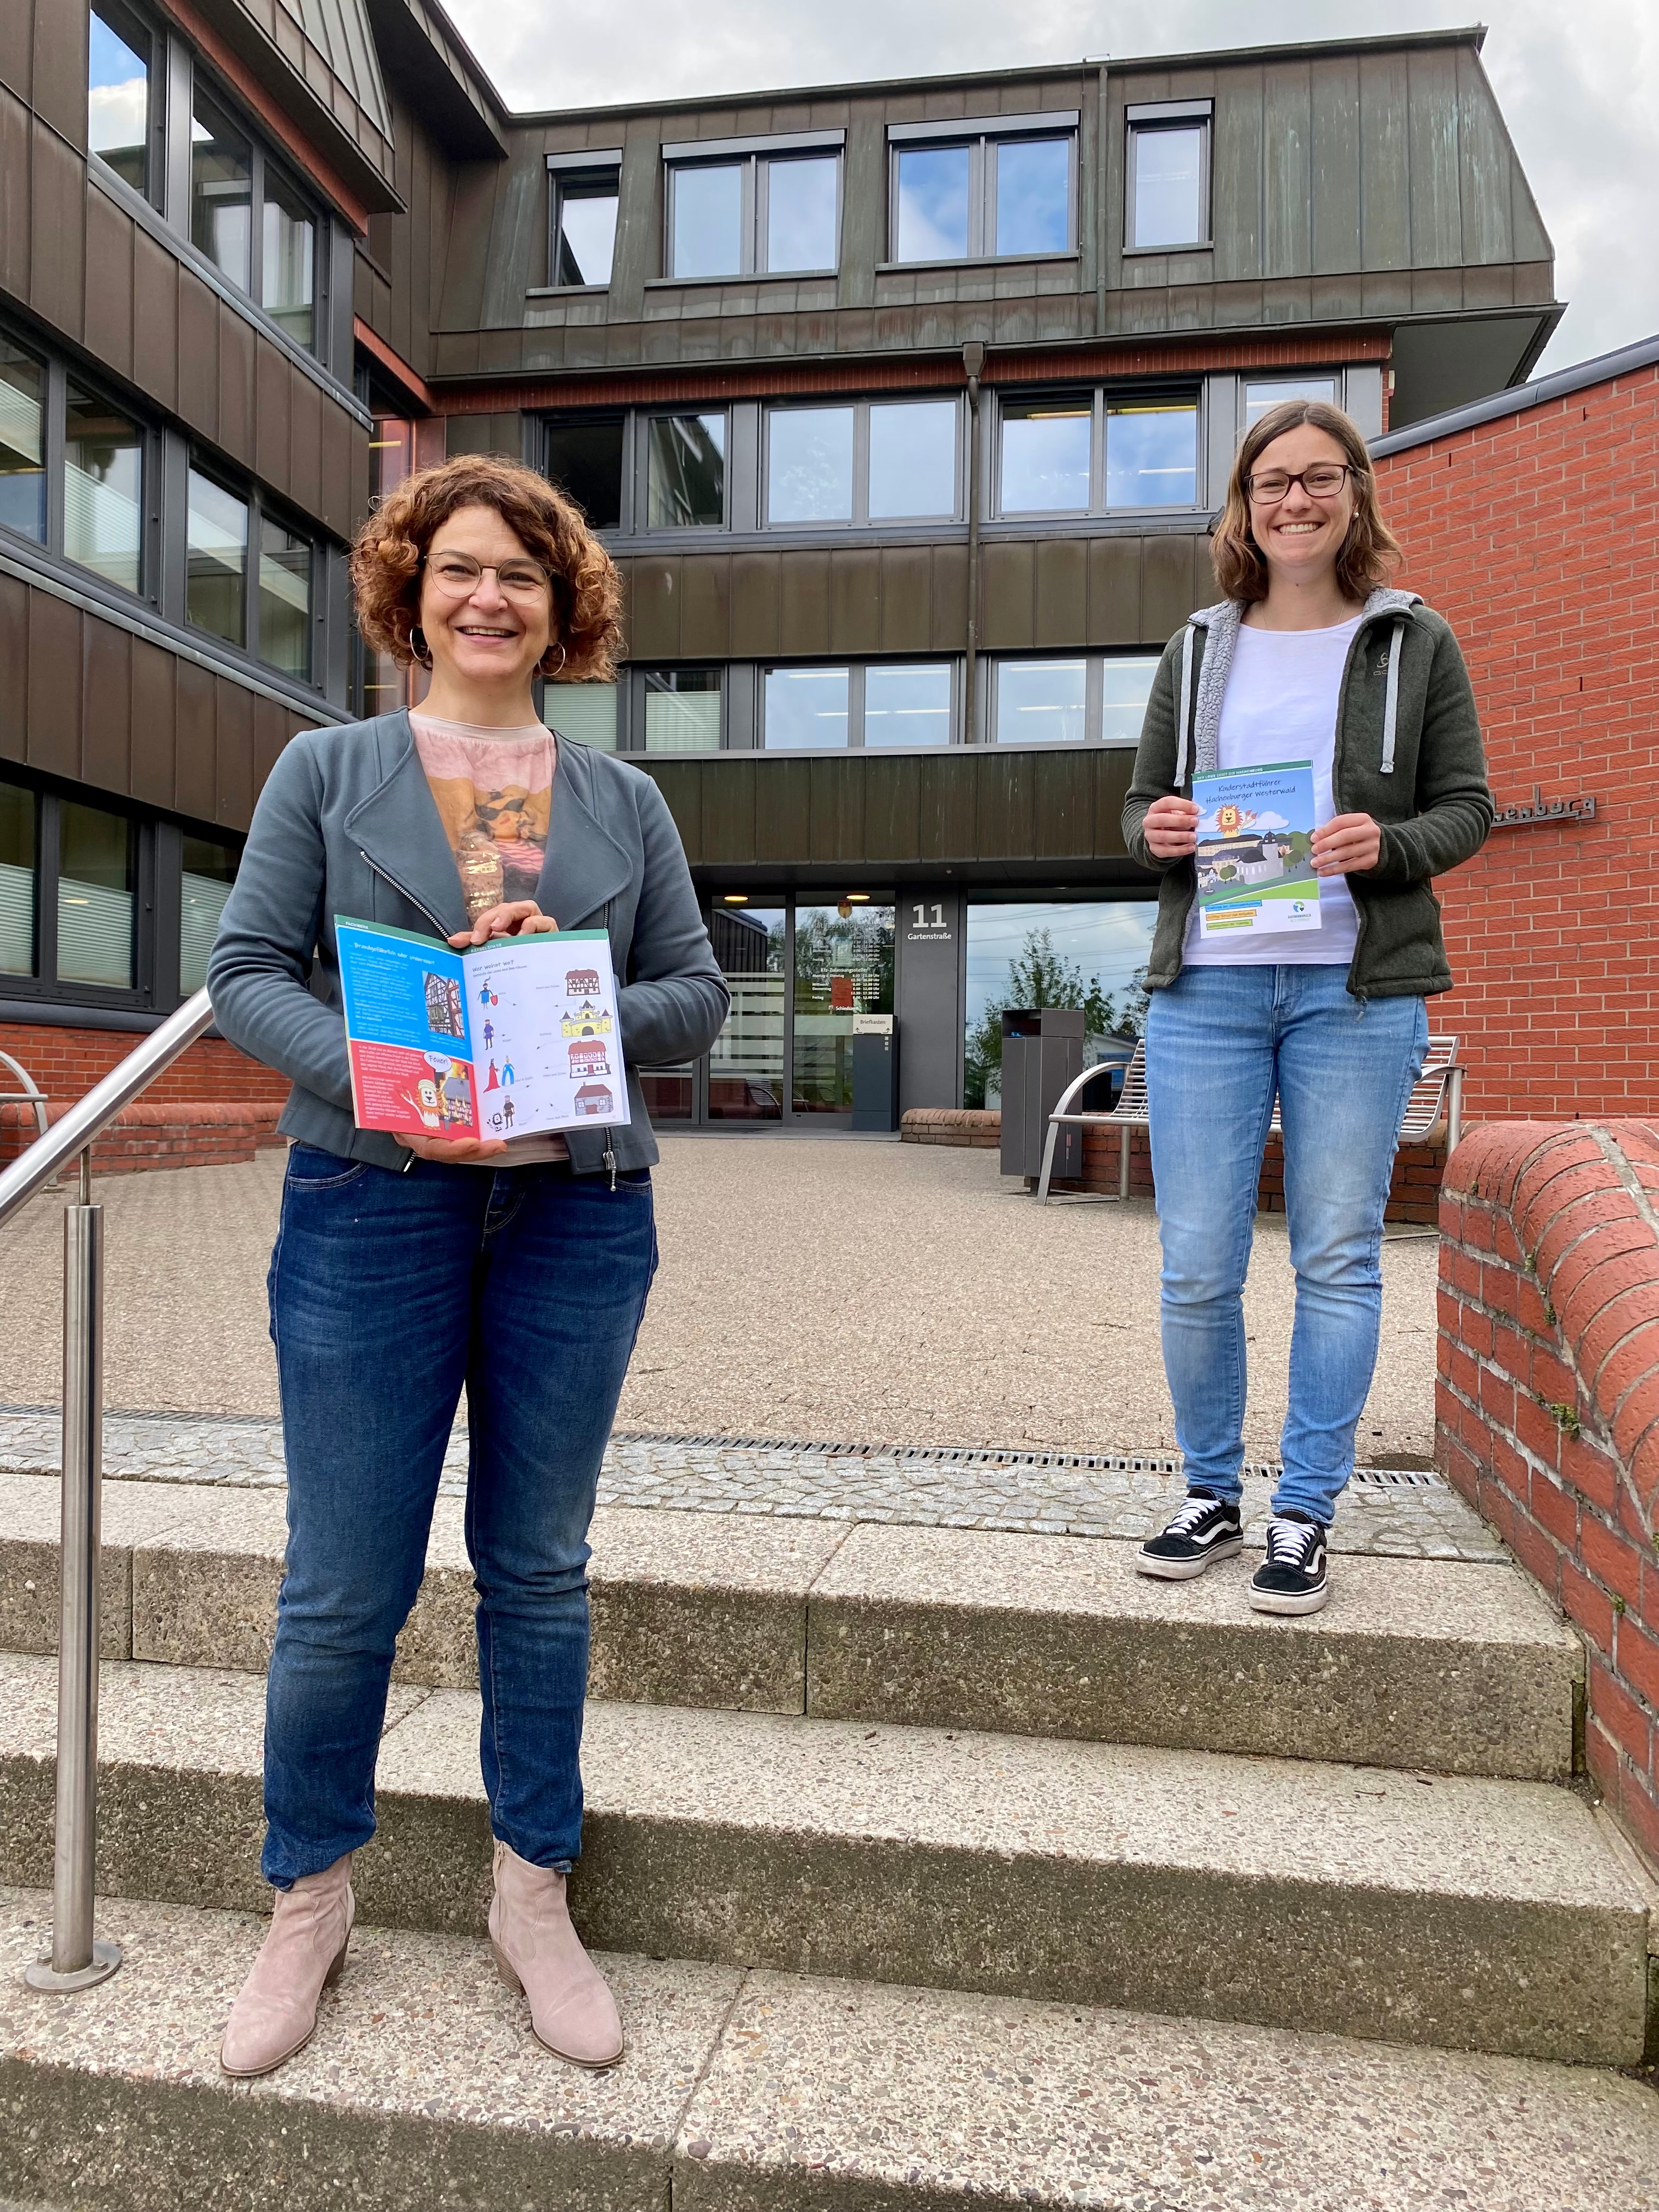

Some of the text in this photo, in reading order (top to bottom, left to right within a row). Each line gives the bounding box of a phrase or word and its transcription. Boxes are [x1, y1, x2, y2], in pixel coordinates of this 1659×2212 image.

[1218, 780, 1282, 792] Kinderstadtführer
[1206, 786, 1296, 804] Hachenburger Westerwald
[912, 904, 947, 928] 11
[345, 921, 369, 930] FACHWERK
[428, 1055, 448, 1064] Feuer!
